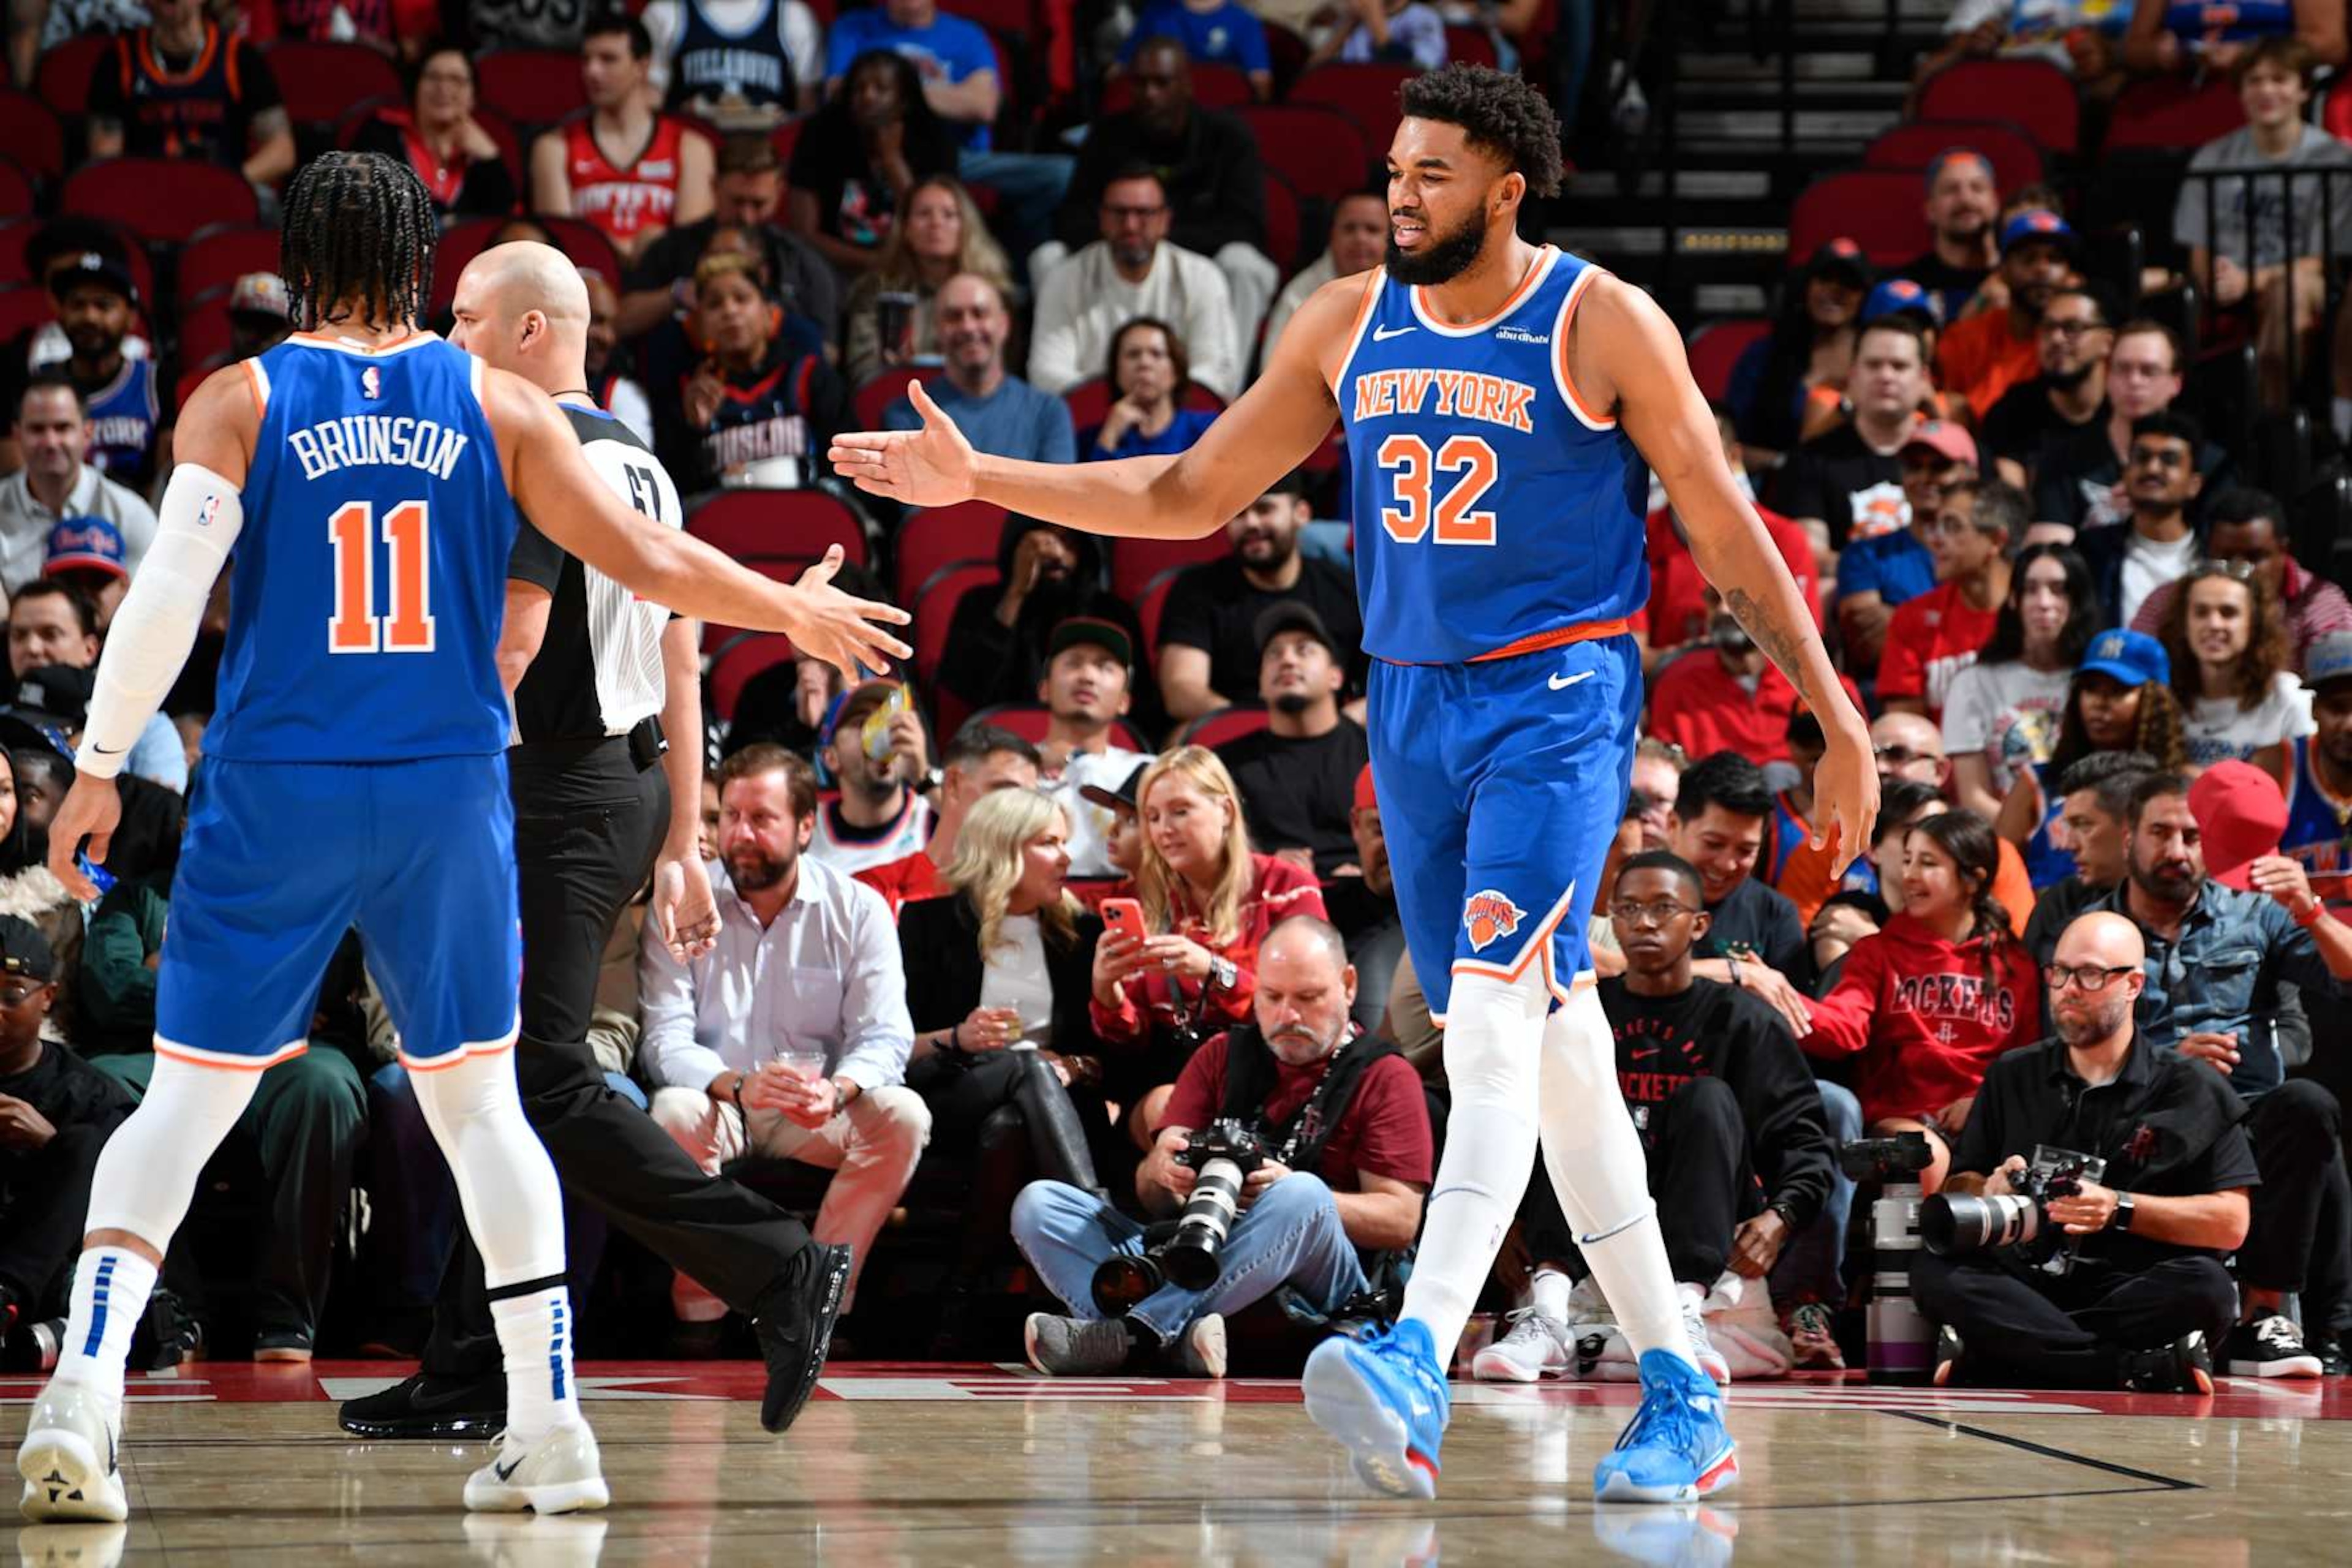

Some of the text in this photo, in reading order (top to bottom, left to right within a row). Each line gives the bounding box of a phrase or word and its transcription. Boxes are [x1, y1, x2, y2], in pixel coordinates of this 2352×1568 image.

[1354, 369, 1536, 434] NEW YORK
[288, 415, 467, 480] BRUNSON
[1378, 435, 1498, 545] 32
[328, 501, 435, 653] 11
[1889, 973, 2015, 1034] ROCKETS
